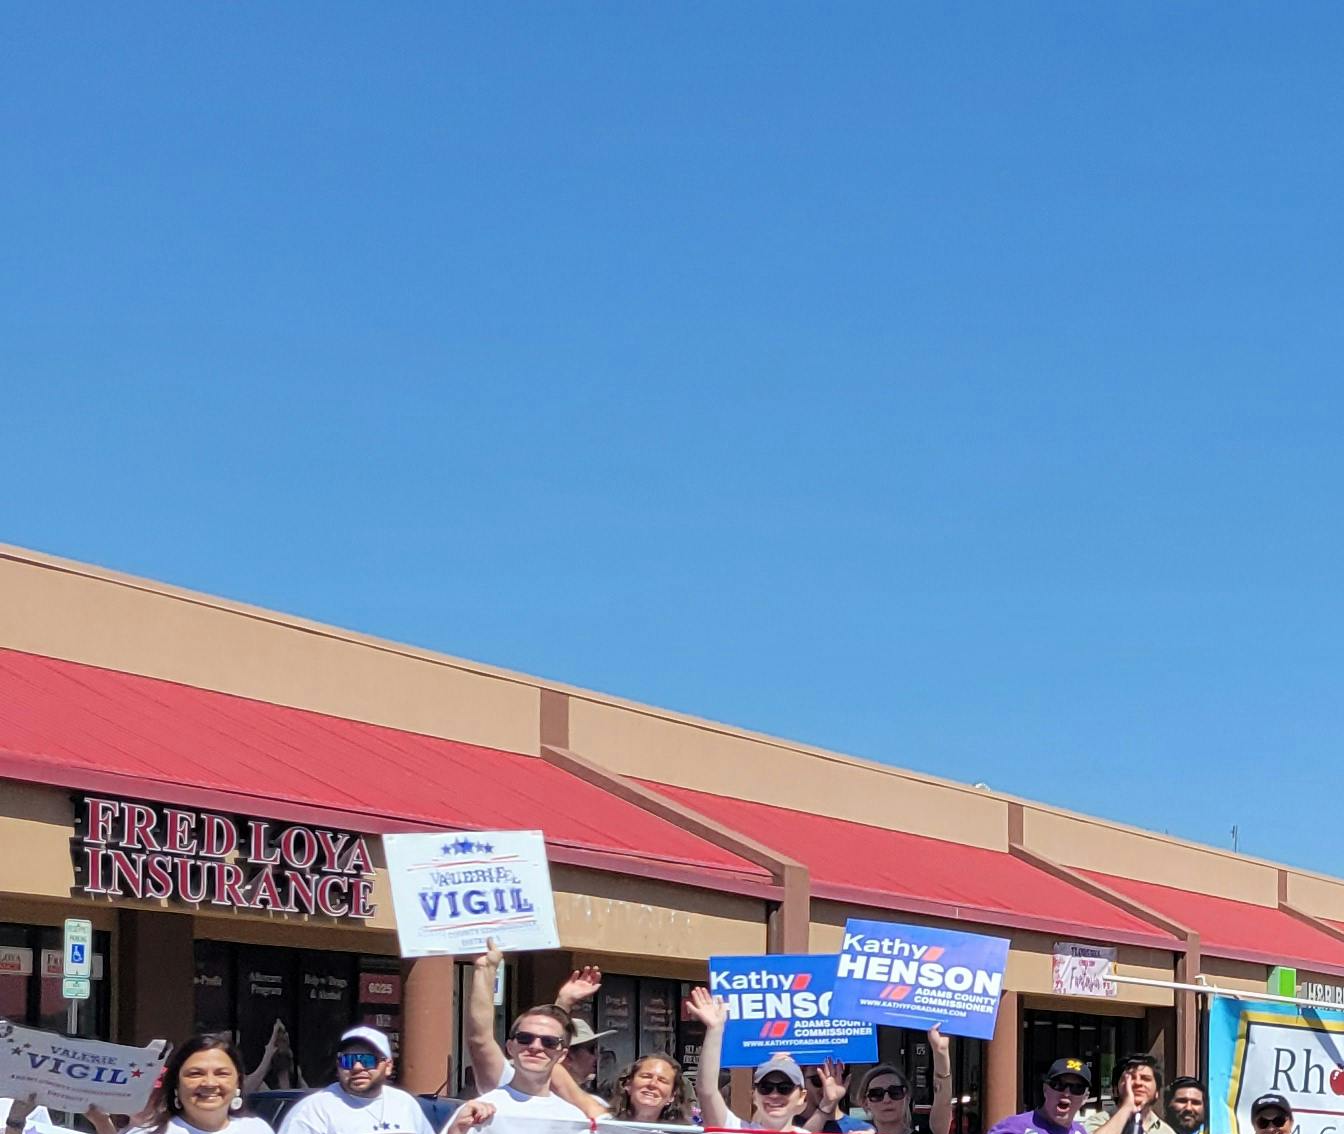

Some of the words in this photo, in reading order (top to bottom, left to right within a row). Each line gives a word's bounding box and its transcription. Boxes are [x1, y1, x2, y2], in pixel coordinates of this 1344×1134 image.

[85, 797, 236, 857] FRED
[248, 820, 375, 876] LOYA
[85, 847, 375, 919] INSURANCE
[418, 888, 534, 921] VIGIL
[843, 933, 928, 959] Kathy
[710, 970, 794, 990] Kathy
[837, 954, 1002, 997] HENSON
[712, 992, 833, 1020] HENS
[914, 996, 994, 1013] COMMISSIONER
[915, 987, 952, 999] ADAMS
[954, 992, 997, 1005] COUNTY
[860, 999, 967, 1017] WWW.KATHYFORADAMS.COM
[794, 1020, 830, 1028] ADAMS
[794, 1028, 872, 1037] COMMISSIONER
[51, 1046, 118, 1065] VALERIE
[27, 1053, 128, 1085] VIGIL
